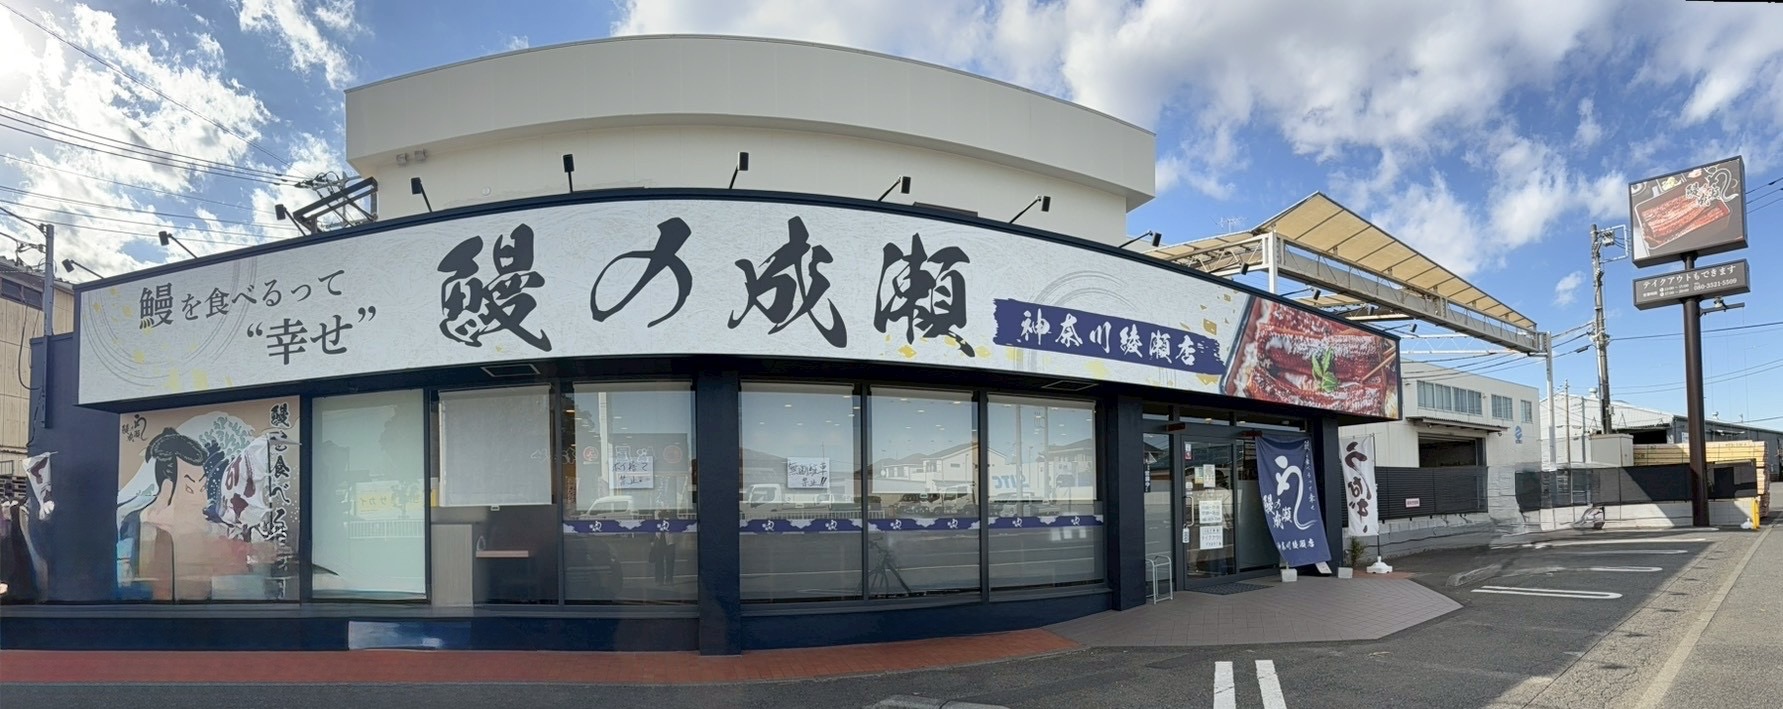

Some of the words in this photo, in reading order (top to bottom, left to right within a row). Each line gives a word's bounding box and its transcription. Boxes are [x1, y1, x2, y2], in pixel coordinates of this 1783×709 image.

[139, 269, 345, 330] 鰻を食べるって
[437, 216, 975, 358] 鰻の成瀬
[1643, 264, 1736, 289] テイクアウトもできます
[1016, 308, 1196, 366] 神奈川綾瀬店
